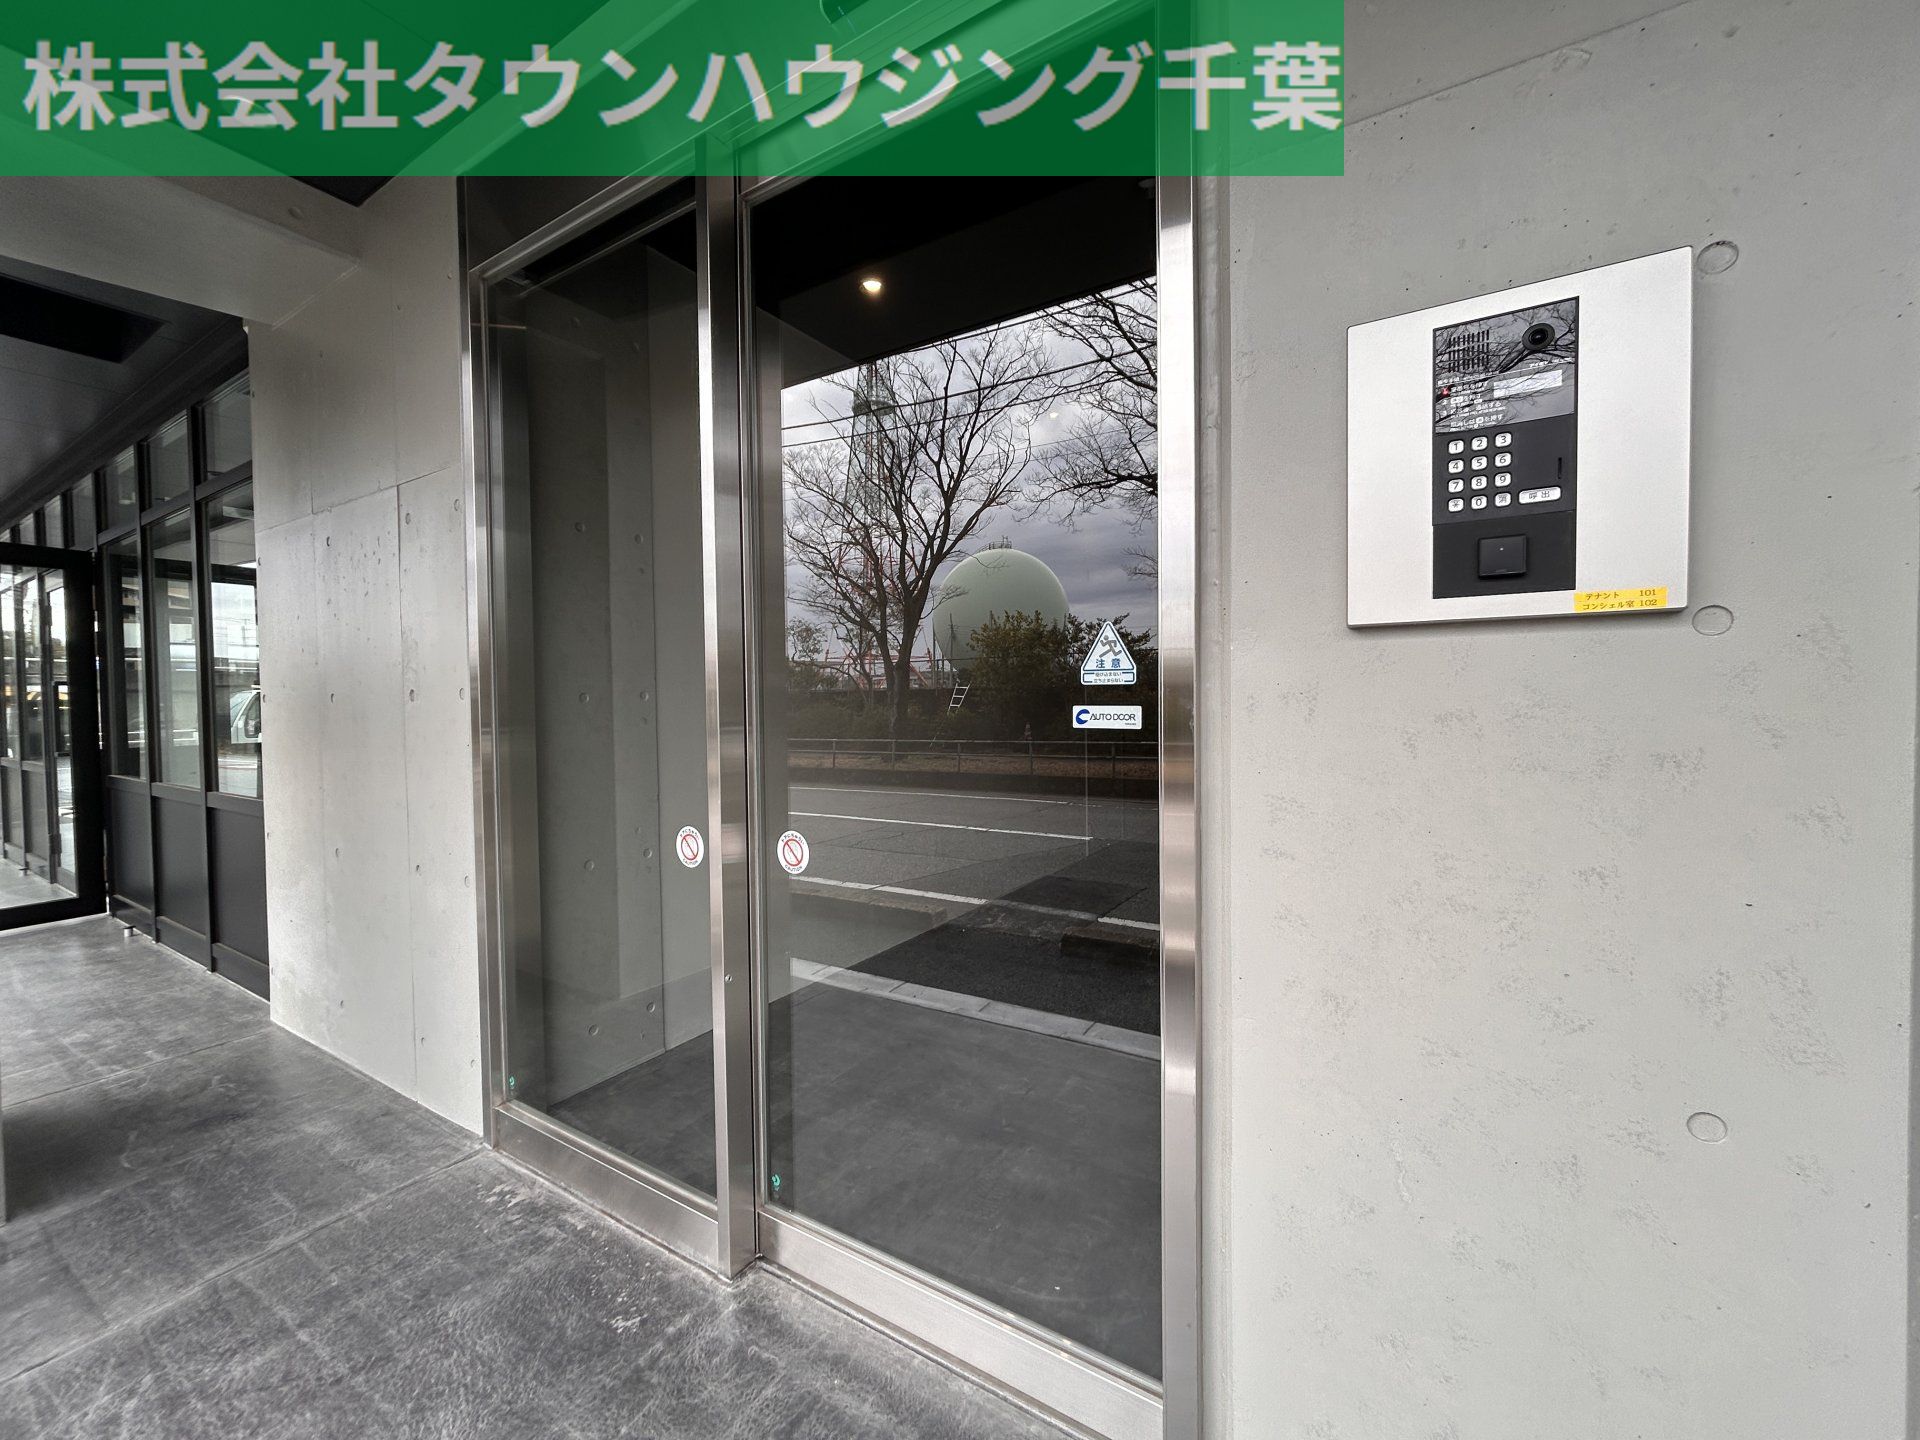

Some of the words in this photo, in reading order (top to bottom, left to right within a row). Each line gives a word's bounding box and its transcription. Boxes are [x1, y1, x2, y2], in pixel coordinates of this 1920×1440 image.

[1454, 443, 1459, 451] 1
[1476, 439, 1483, 448] 2
[1500, 435, 1507, 444] 3
[1452, 462, 1459, 470] 4
[1476, 459, 1483, 467] 5
[1499, 455, 1507, 464] 6
[1452, 481, 1460, 490] 7
[1475, 478, 1483, 487] 8
[1499, 475, 1507, 484] 9
[1475, 498, 1483, 507] 0
[1585, 591, 1620, 601] テナント
[1639, 589, 1656, 597] 101
[1582, 600, 1635, 611] コンシェル室
[1639, 599, 1658, 607] 102
[1096, 658, 1121, 669] 注意
[1090, 713, 1112, 721] AUTO
